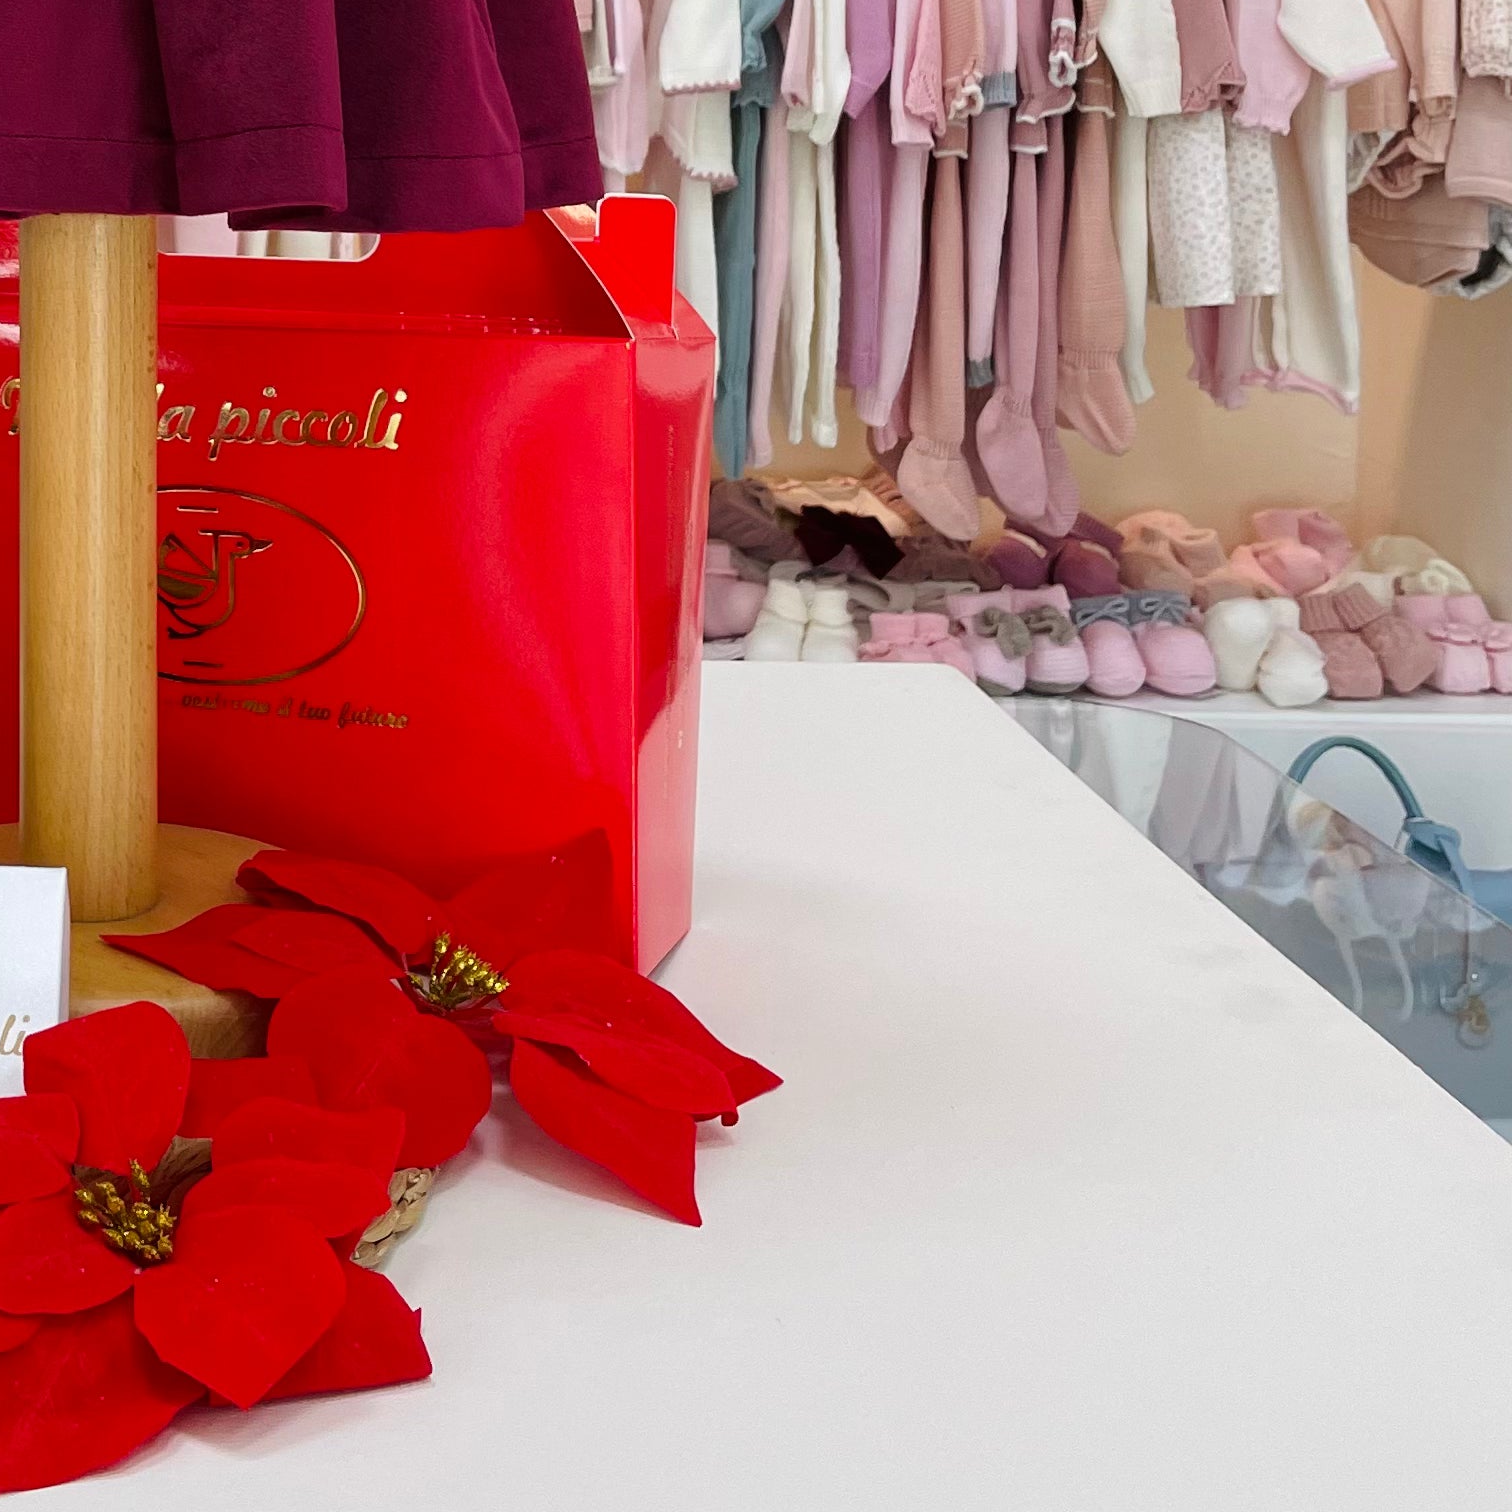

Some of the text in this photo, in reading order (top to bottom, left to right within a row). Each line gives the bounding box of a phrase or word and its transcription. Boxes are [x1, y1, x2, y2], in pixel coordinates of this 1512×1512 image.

[209, 385, 408, 461] piccoli
[298, 700, 331, 720] tuo
[337, 701, 409, 729] futuro
